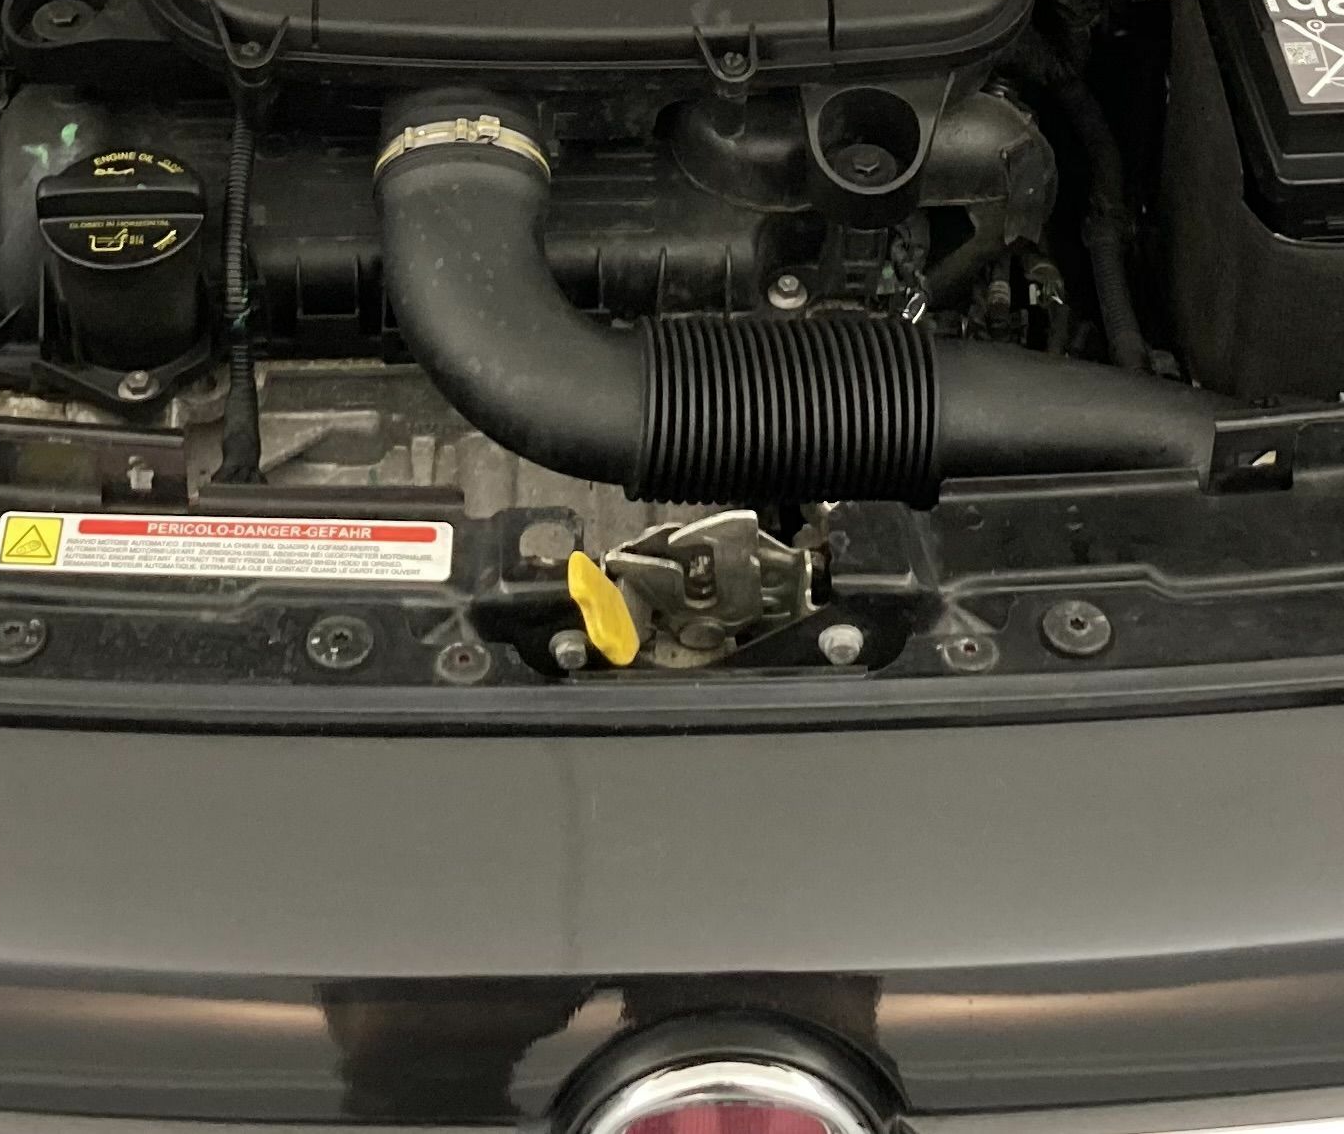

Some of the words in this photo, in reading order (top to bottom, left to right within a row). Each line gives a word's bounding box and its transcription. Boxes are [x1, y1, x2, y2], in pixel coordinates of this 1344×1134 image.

[93, 151, 137, 167] ENGINE
[138, 152, 155, 164] OIL
[147, 521, 372, 540] PERICOLO-DANGER-GEFAHR
